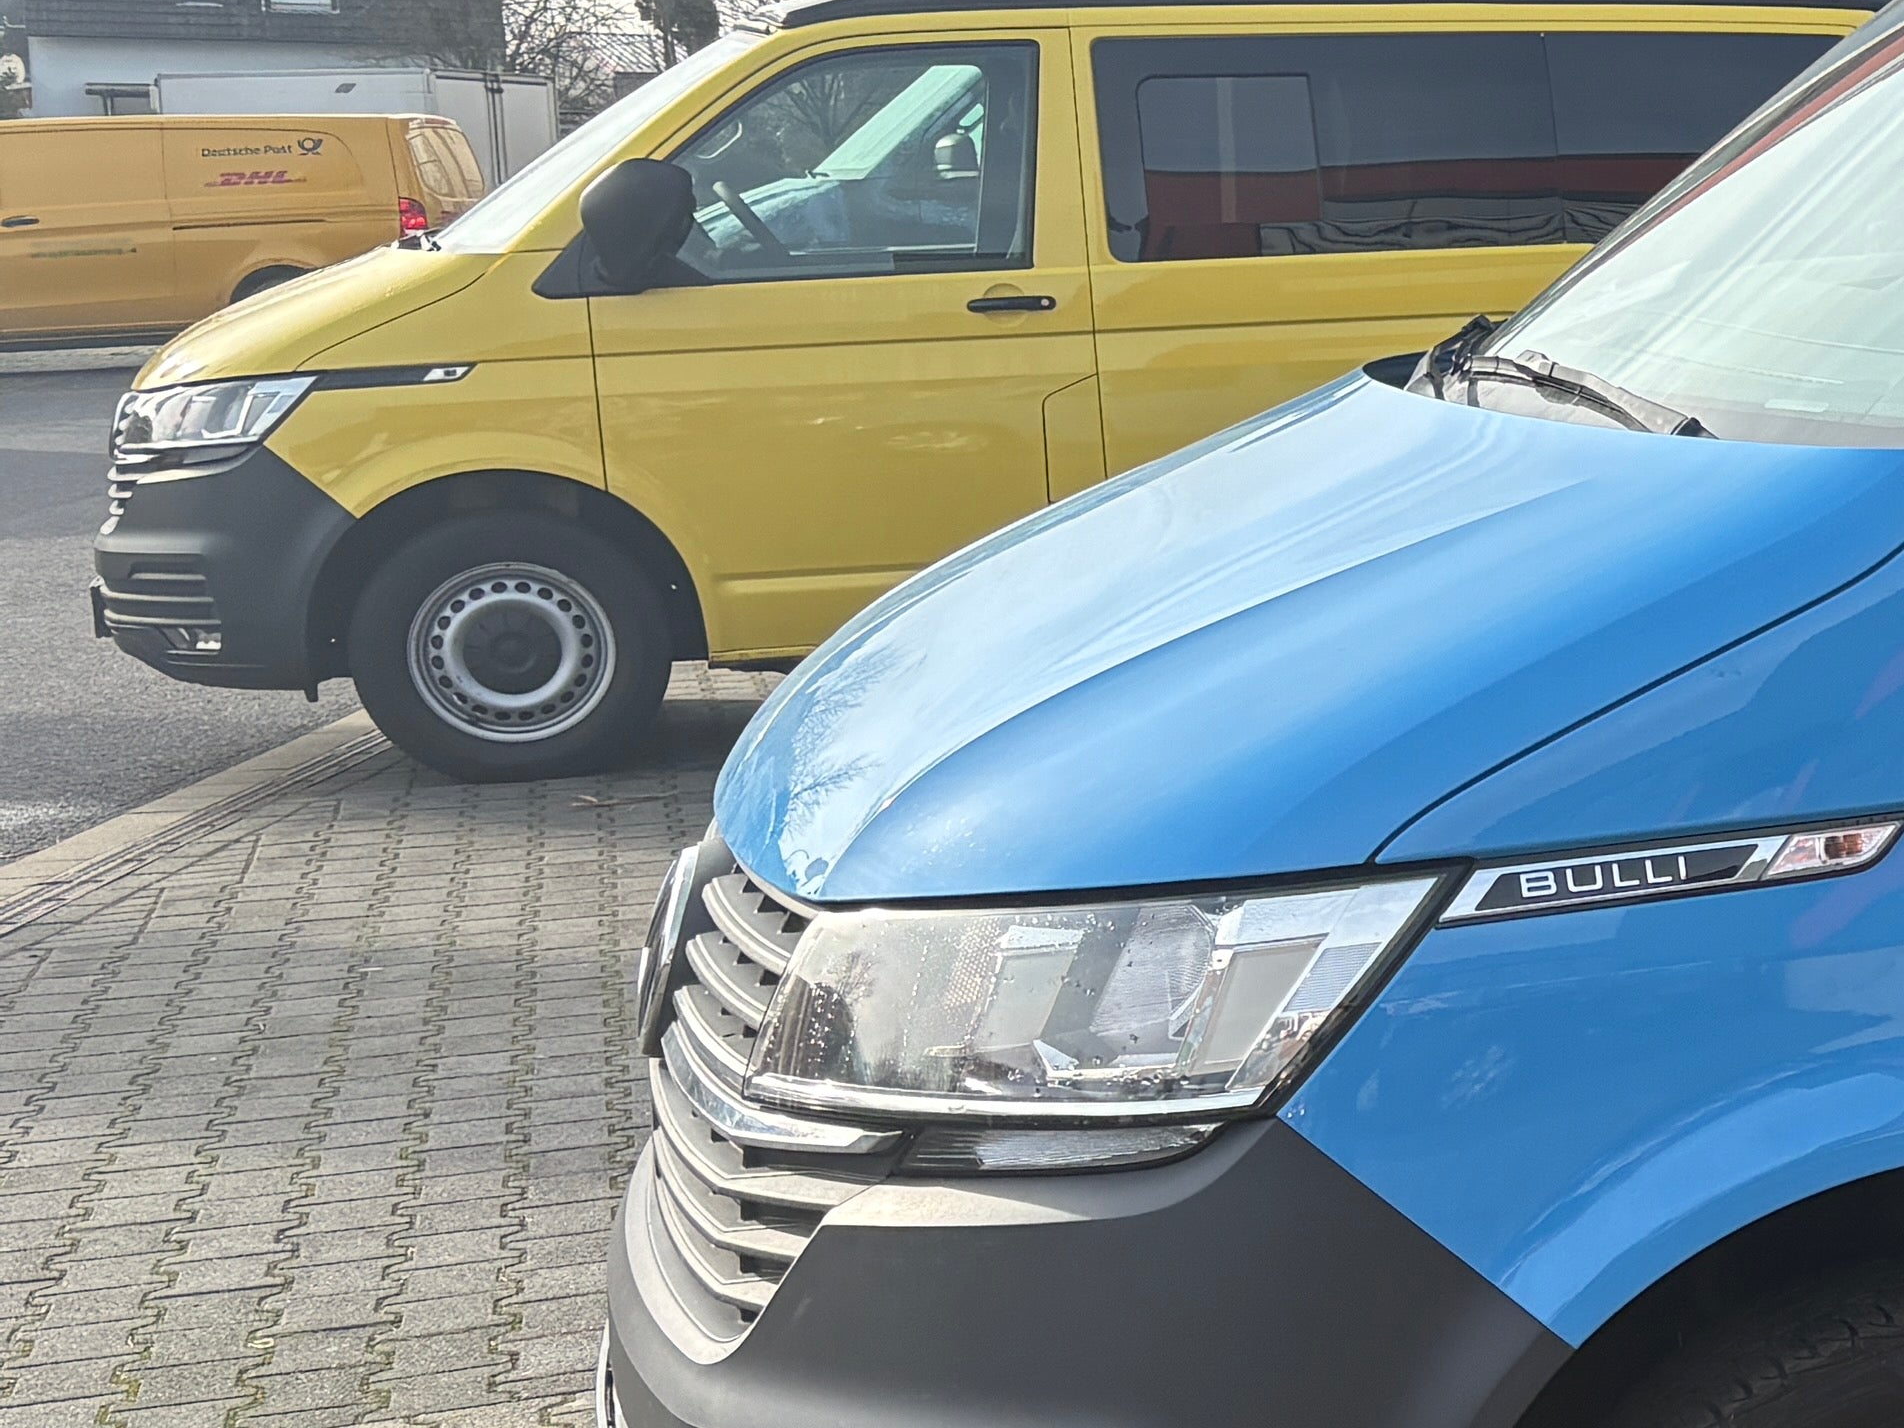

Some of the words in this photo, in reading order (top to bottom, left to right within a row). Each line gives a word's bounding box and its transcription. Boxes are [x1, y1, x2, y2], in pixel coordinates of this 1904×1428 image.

[201, 146, 261, 158] Deutsche
[263, 144, 293, 155] Post
[216, 170, 290, 187] DHL
[1519, 855, 1687, 899] BULLI
